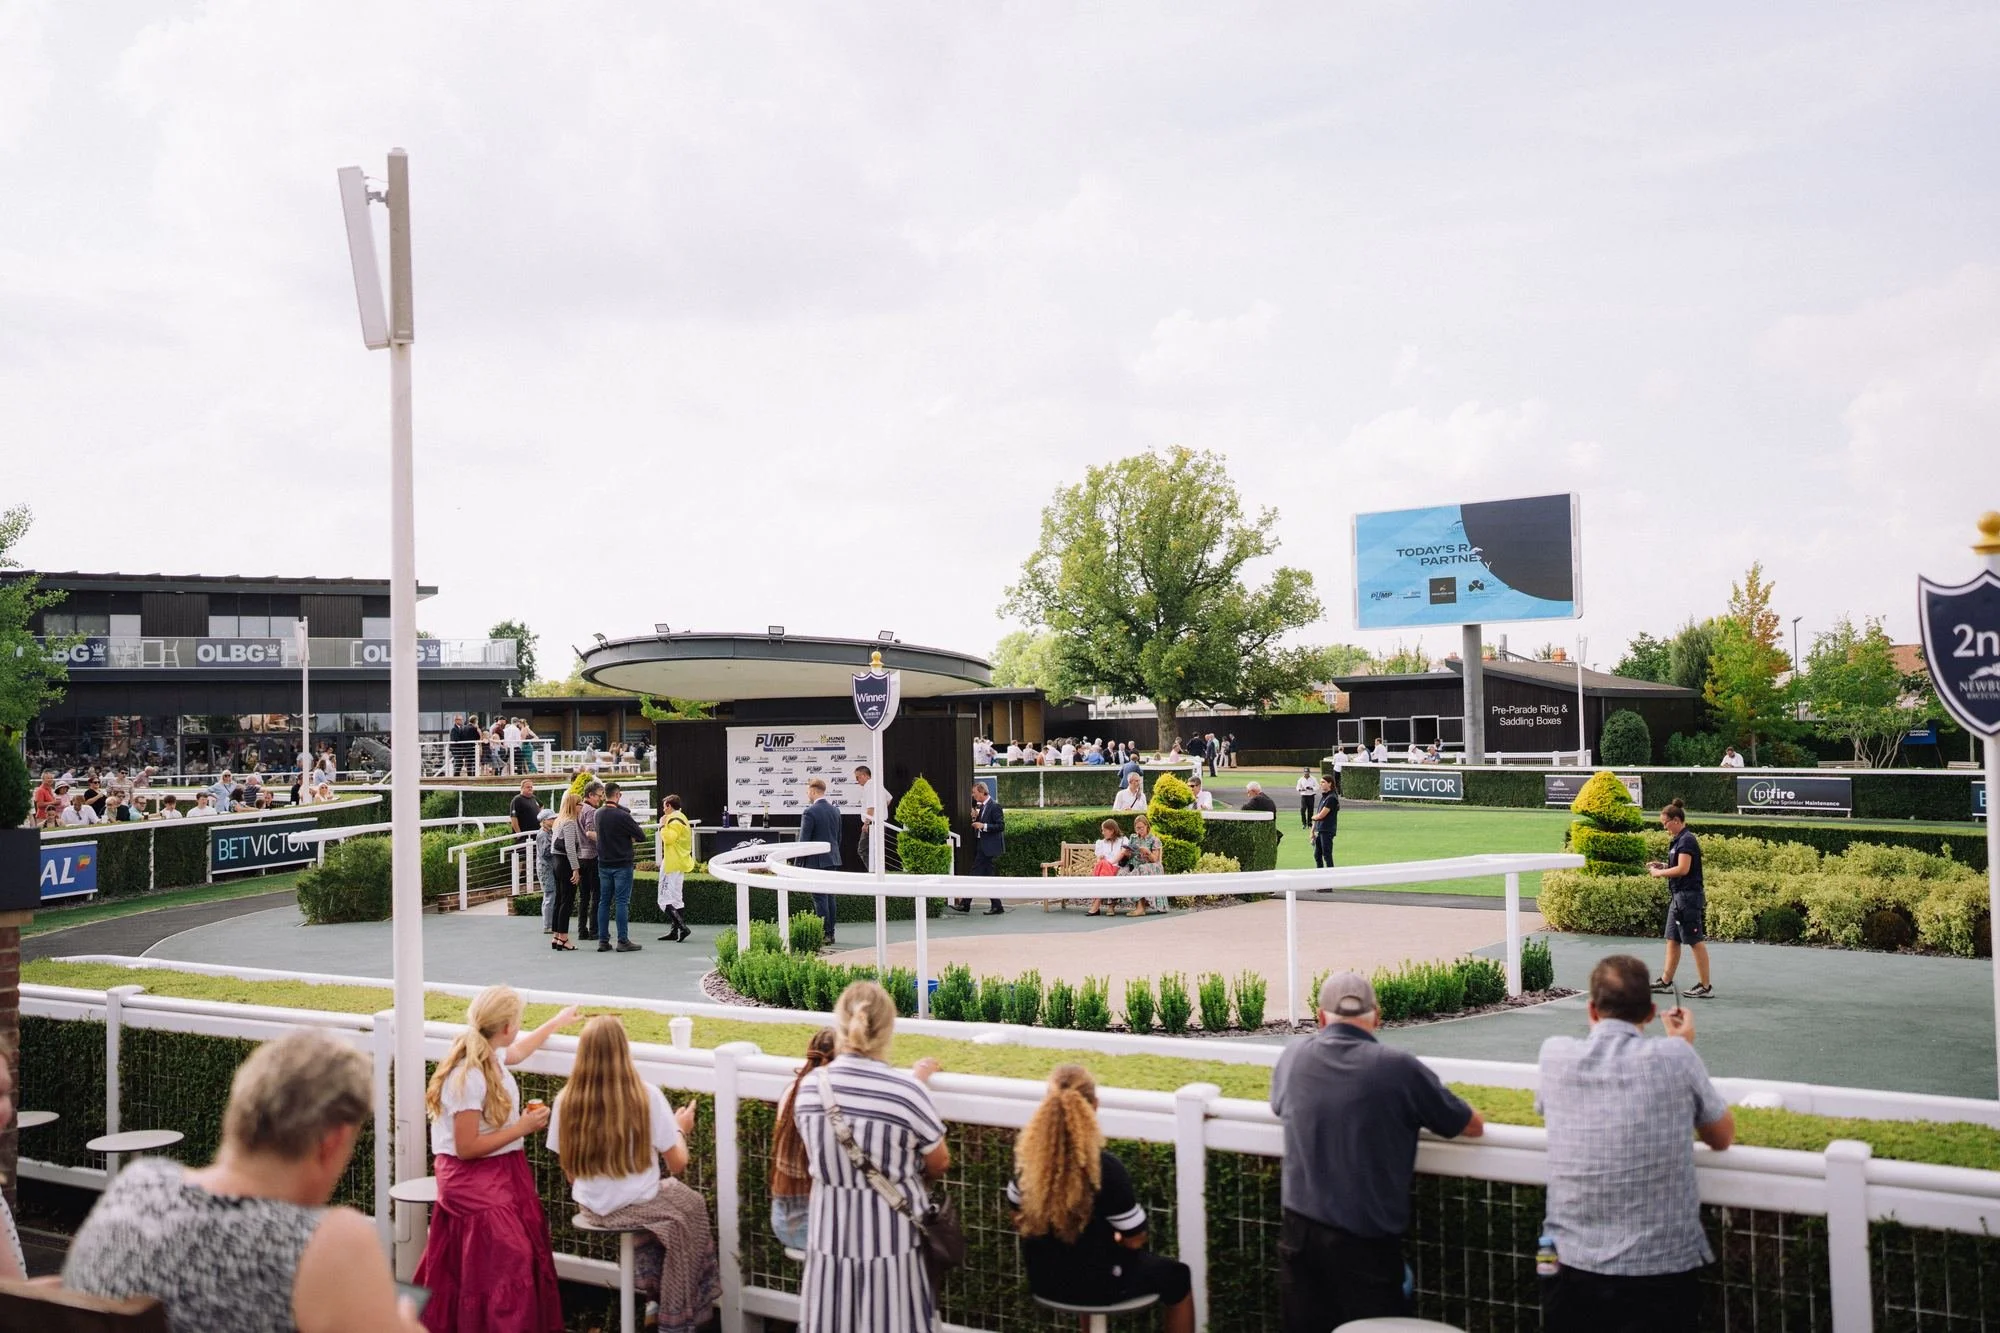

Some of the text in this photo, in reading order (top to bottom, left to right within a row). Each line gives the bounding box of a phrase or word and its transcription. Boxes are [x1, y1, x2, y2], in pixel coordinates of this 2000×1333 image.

[1396, 544, 1455, 558] TODAY'S
[1420, 553, 1482, 566] PARTNE
[197, 644, 265, 663] OLBG
[363, 644, 426, 663] OLG
[857, 693, 887, 703] Winner
[1492, 704, 1569, 715] Pre-Parade Ring &
[1499, 716, 1562, 727] Saddling Boxes
[755, 733, 795, 748] PUMP
[1384, 777, 1456, 793] BETVICTOR
[1753, 788, 1796, 801] tptfire
